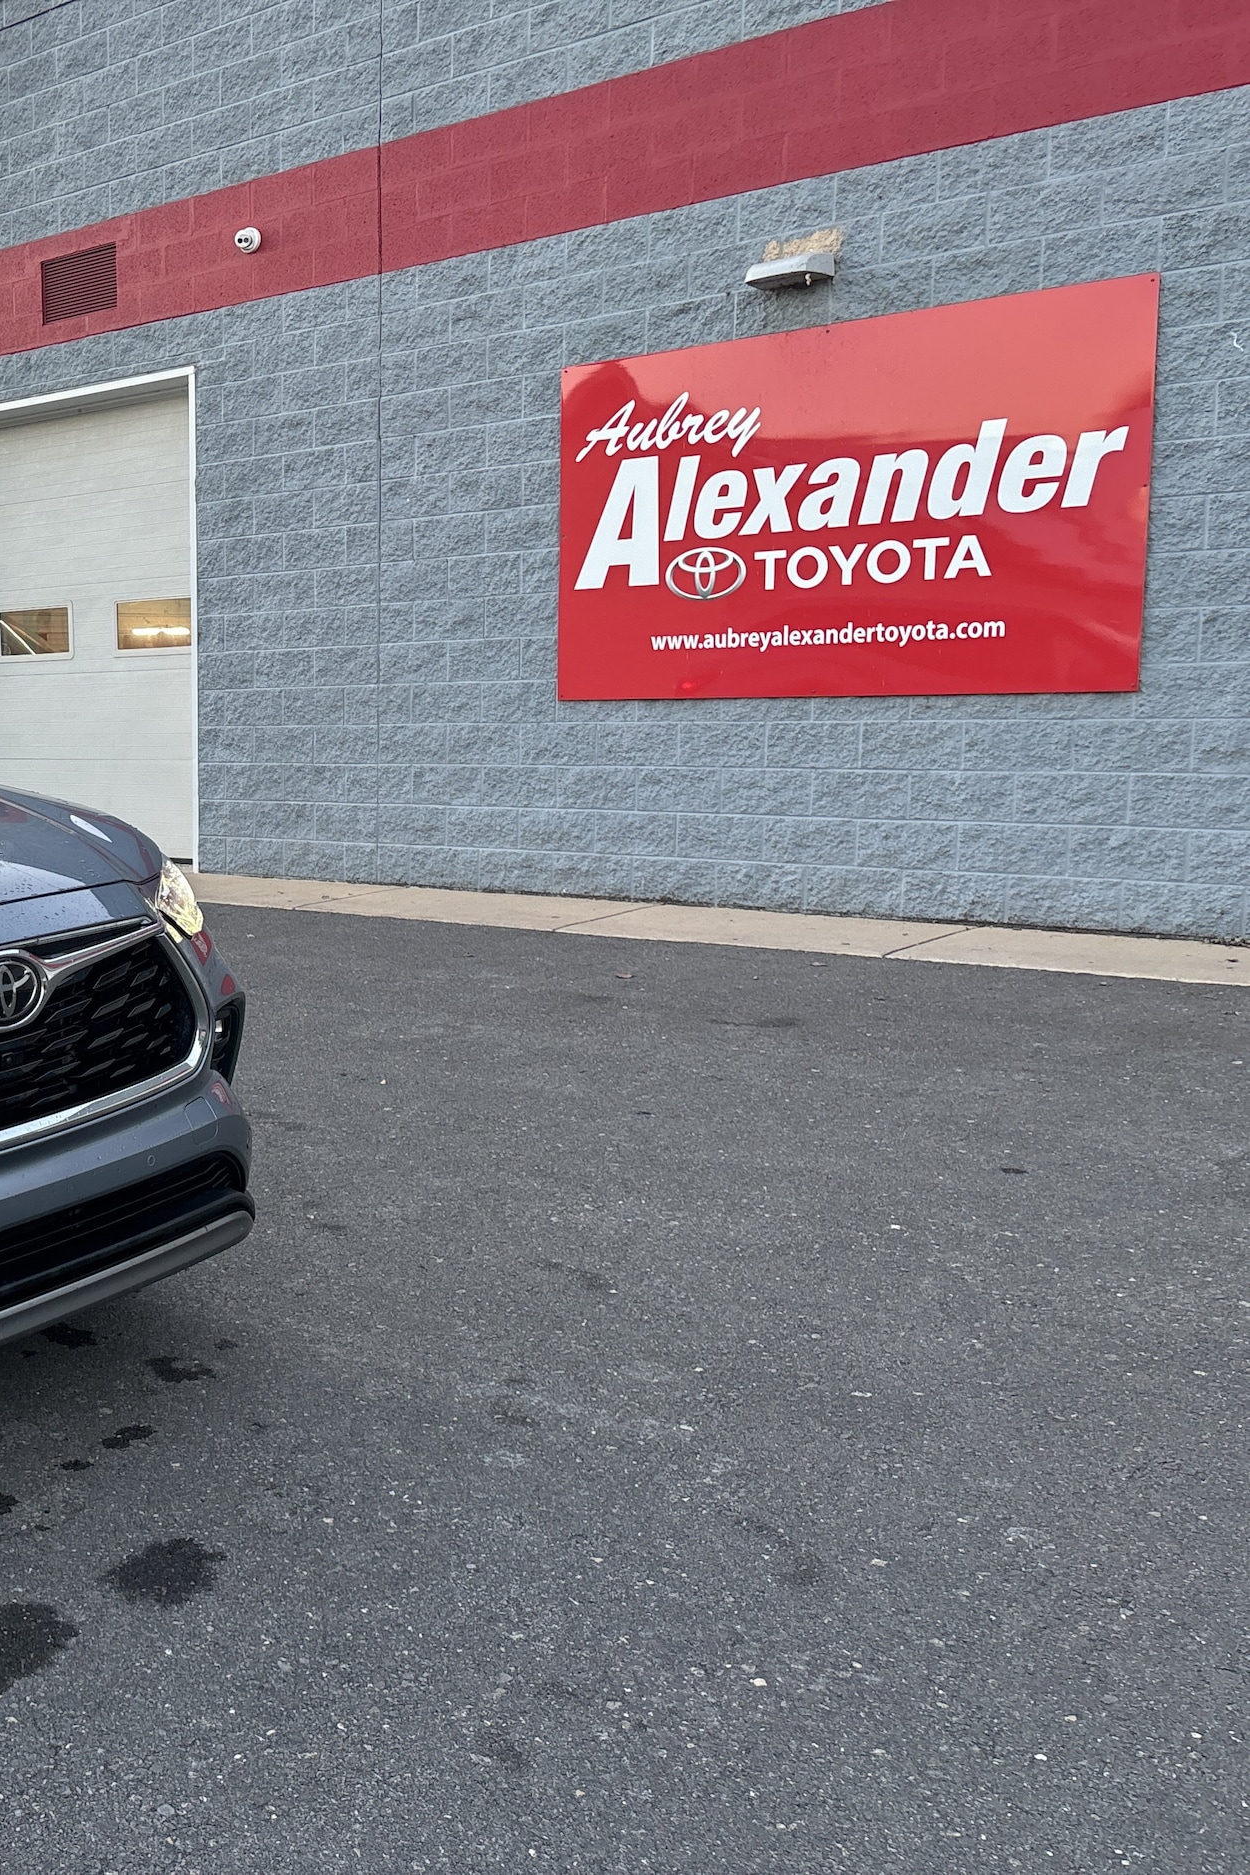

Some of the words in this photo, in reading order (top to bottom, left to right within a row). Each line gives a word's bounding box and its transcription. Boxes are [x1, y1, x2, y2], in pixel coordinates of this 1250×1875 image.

[576, 391, 761, 462] Aubrey
[573, 418, 1129, 591] Alexander
[755, 535, 992, 589] TOYOTA
[651, 619, 1006, 653] www.aubreyalexandertoyota.com
